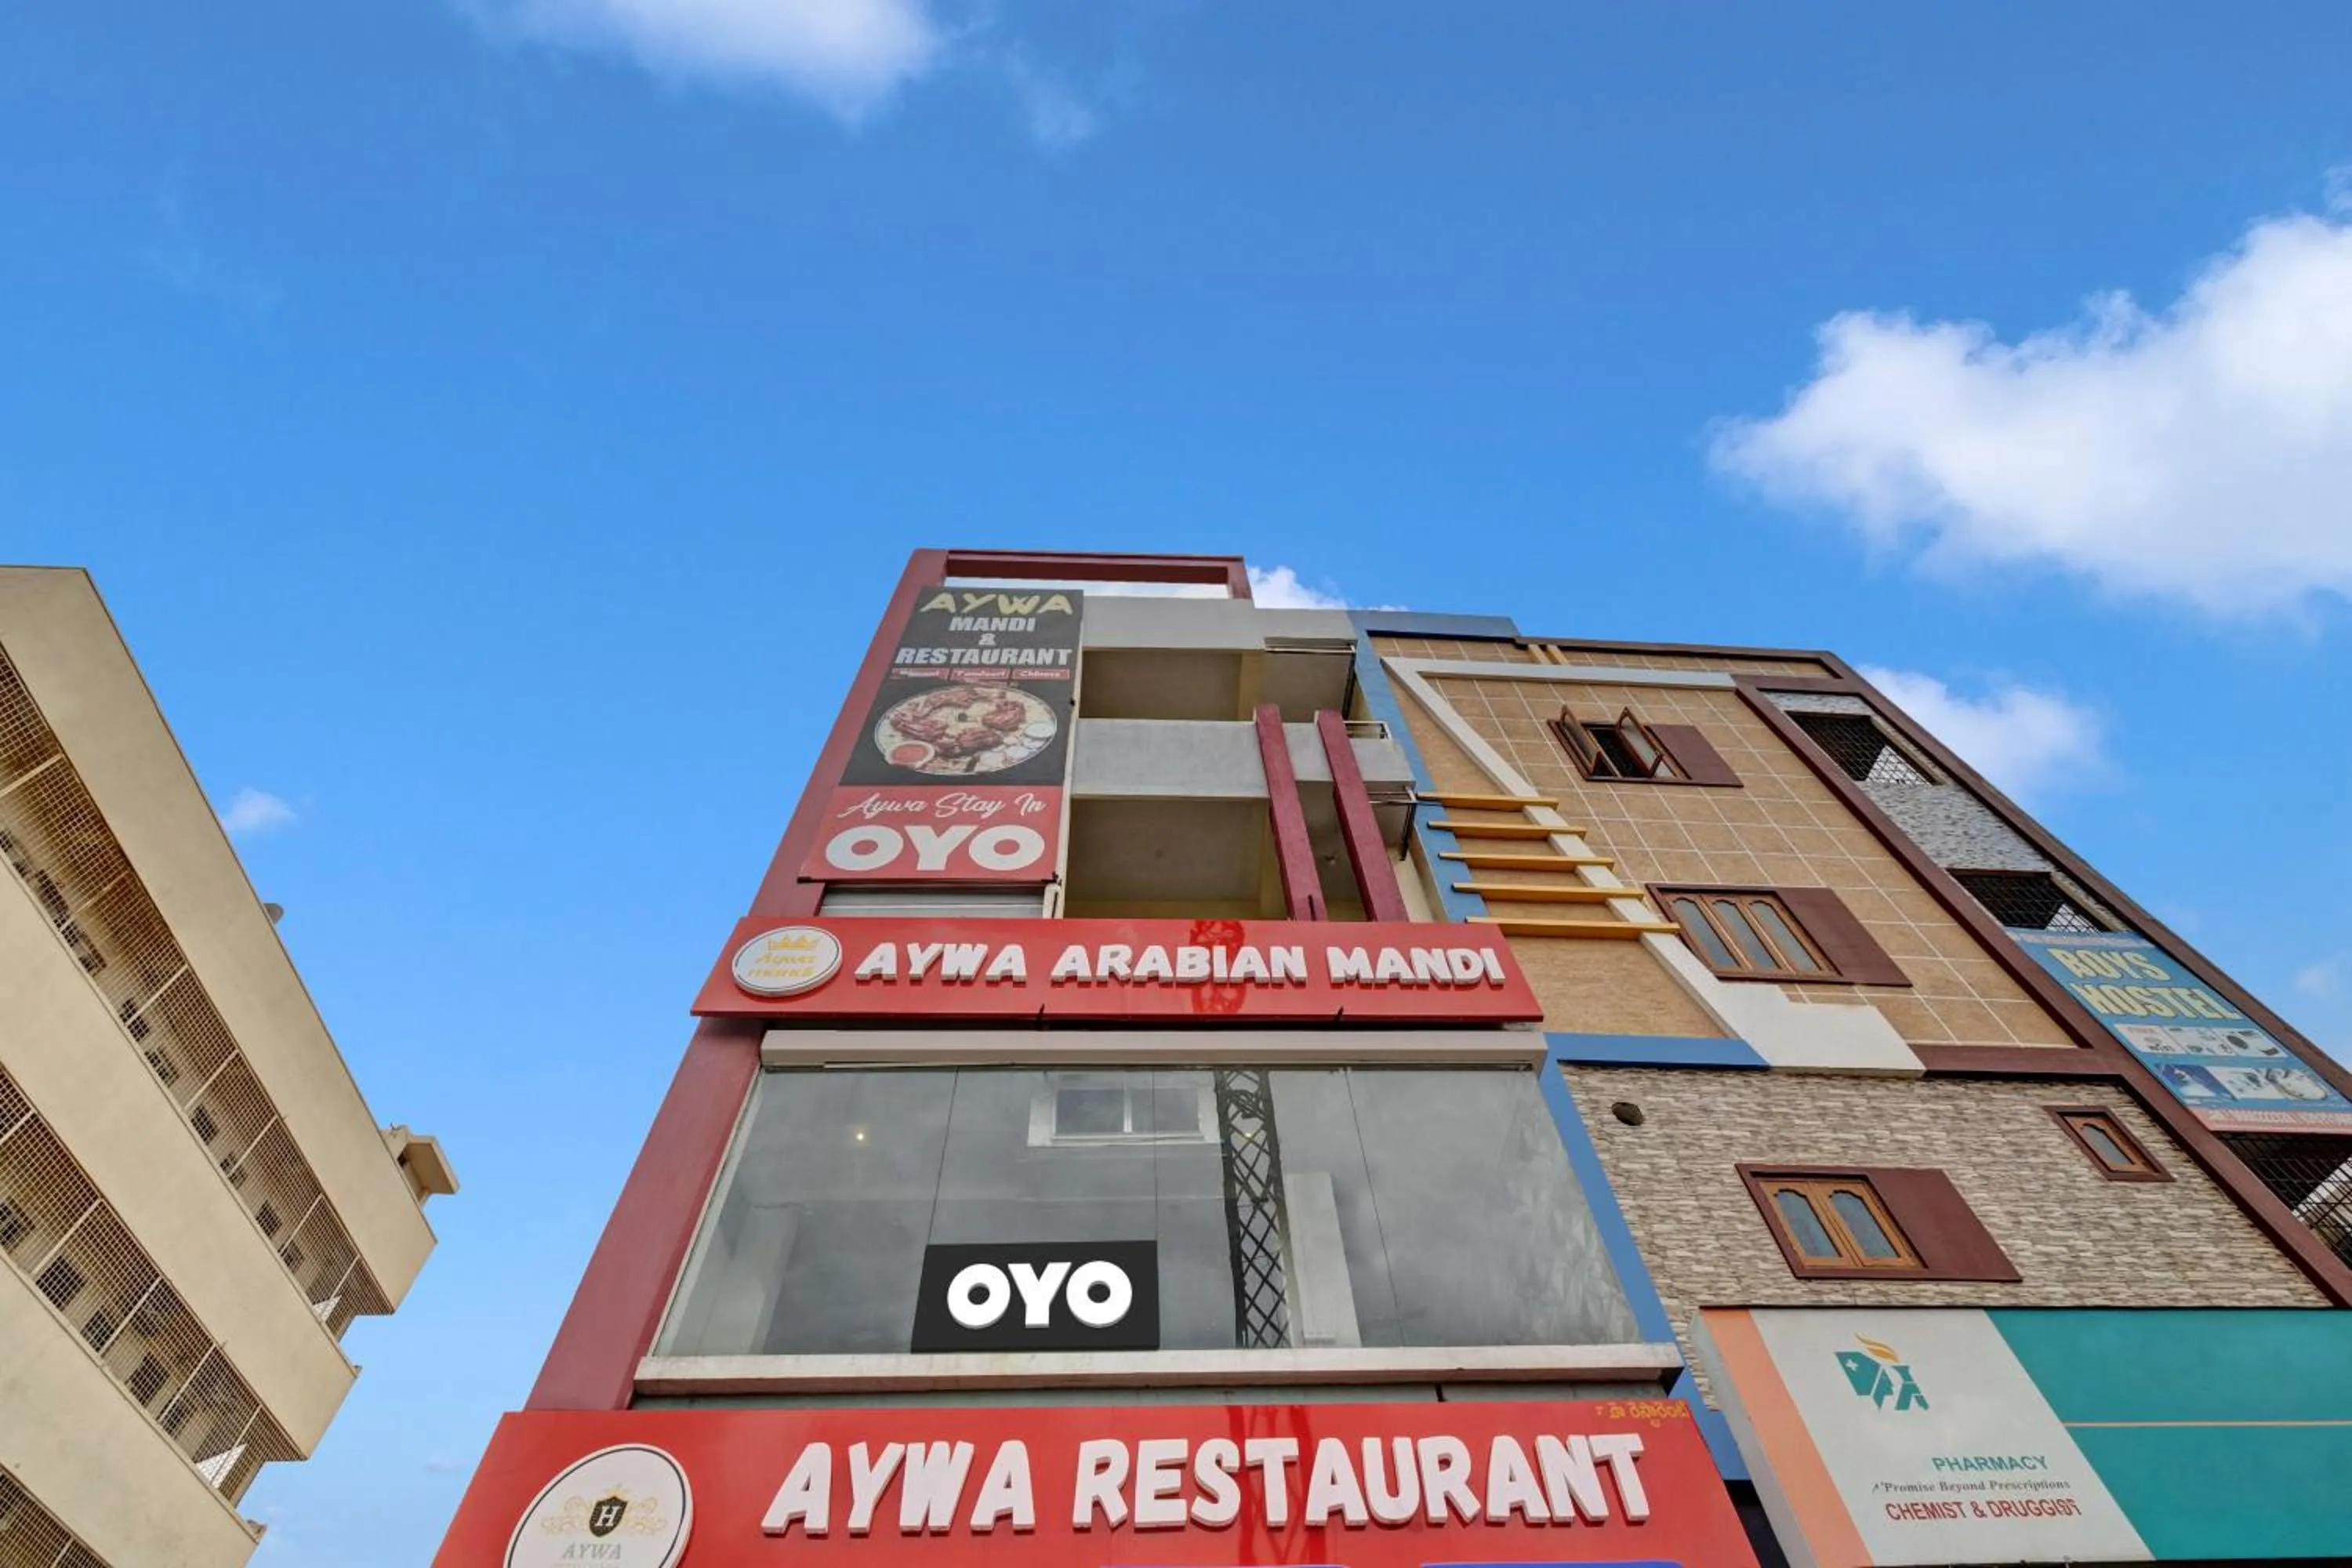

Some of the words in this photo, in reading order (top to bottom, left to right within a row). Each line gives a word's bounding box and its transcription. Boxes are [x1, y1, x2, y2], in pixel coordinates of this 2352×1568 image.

[920, 592, 1073, 615] AYWA
[949, 616, 1036, 633] MANDI
[978, 633, 996, 646] &
[895, 648, 1073, 665] RESTAURANT
[837, 793, 927, 818] Aywa
[935, 793, 1006, 818] Stay
[1014, 793, 1046, 817] In
[826, 825, 1045, 871] OYO
[853, 942, 1027, 983] AYWA
[1051, 944, 1307, 983] ARABIAN
[1326, 946, 1506, 985] MANDI
[2046, 947, 2171, 981] BOYS
[2069, 982, 2242, 1020] HOSTEL
[947, 1261, 1132, 1330] OYO
[1931, 1455, 2050, 1472] PHARMACY
[760, 1439, 1035, 1535] AYWA
[1072, 1433, 1650, 1530] RESTAURANT
[1884, 1481, 1936, 1493] Promise
[1939, 1480, 1986, 1494] Beyond
[1989, 1479, 2071, 1491] Prescriptions
[594, 1505, 622, 1527] H
[1885, 1501, 1968, 1521] CHEMIST
[1969, 1500, 1987, 1519] &
[1986, 1498, 2082, 1519] DRUGGIST
[561, 1542, 622, 1560] AYWA
